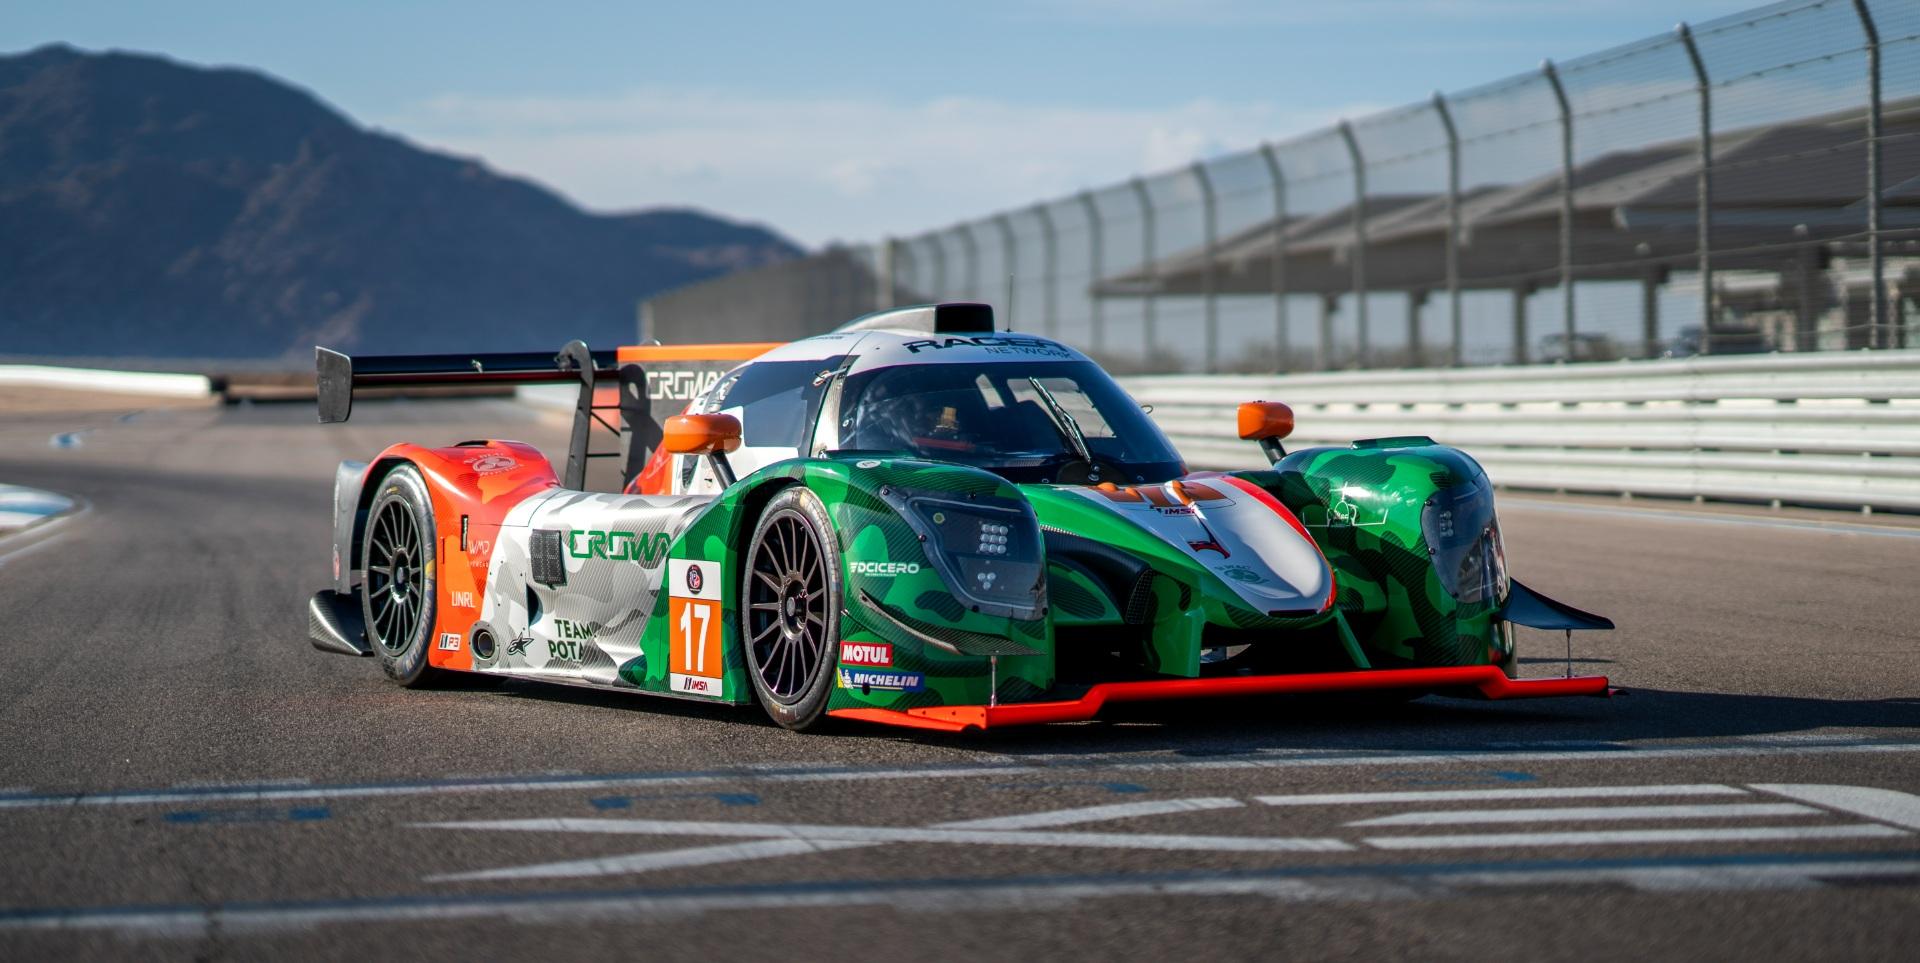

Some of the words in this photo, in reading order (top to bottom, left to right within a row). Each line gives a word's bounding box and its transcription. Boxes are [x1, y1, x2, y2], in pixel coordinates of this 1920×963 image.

[902, 337, 1069, 353] RACER
[985, 346, 1073, 359] NETWORK
[451, 591, 477, 608] UNRL
[554, 619, 593, 645] TEAM
[680, 602, 711, 672] 17
[448, 636, 460, 648] P3
[842, 644, 890, 664] MOTUL
[692, 680, 709, 692] IMSA
[853, 673, 919, 687] MICHELIN
